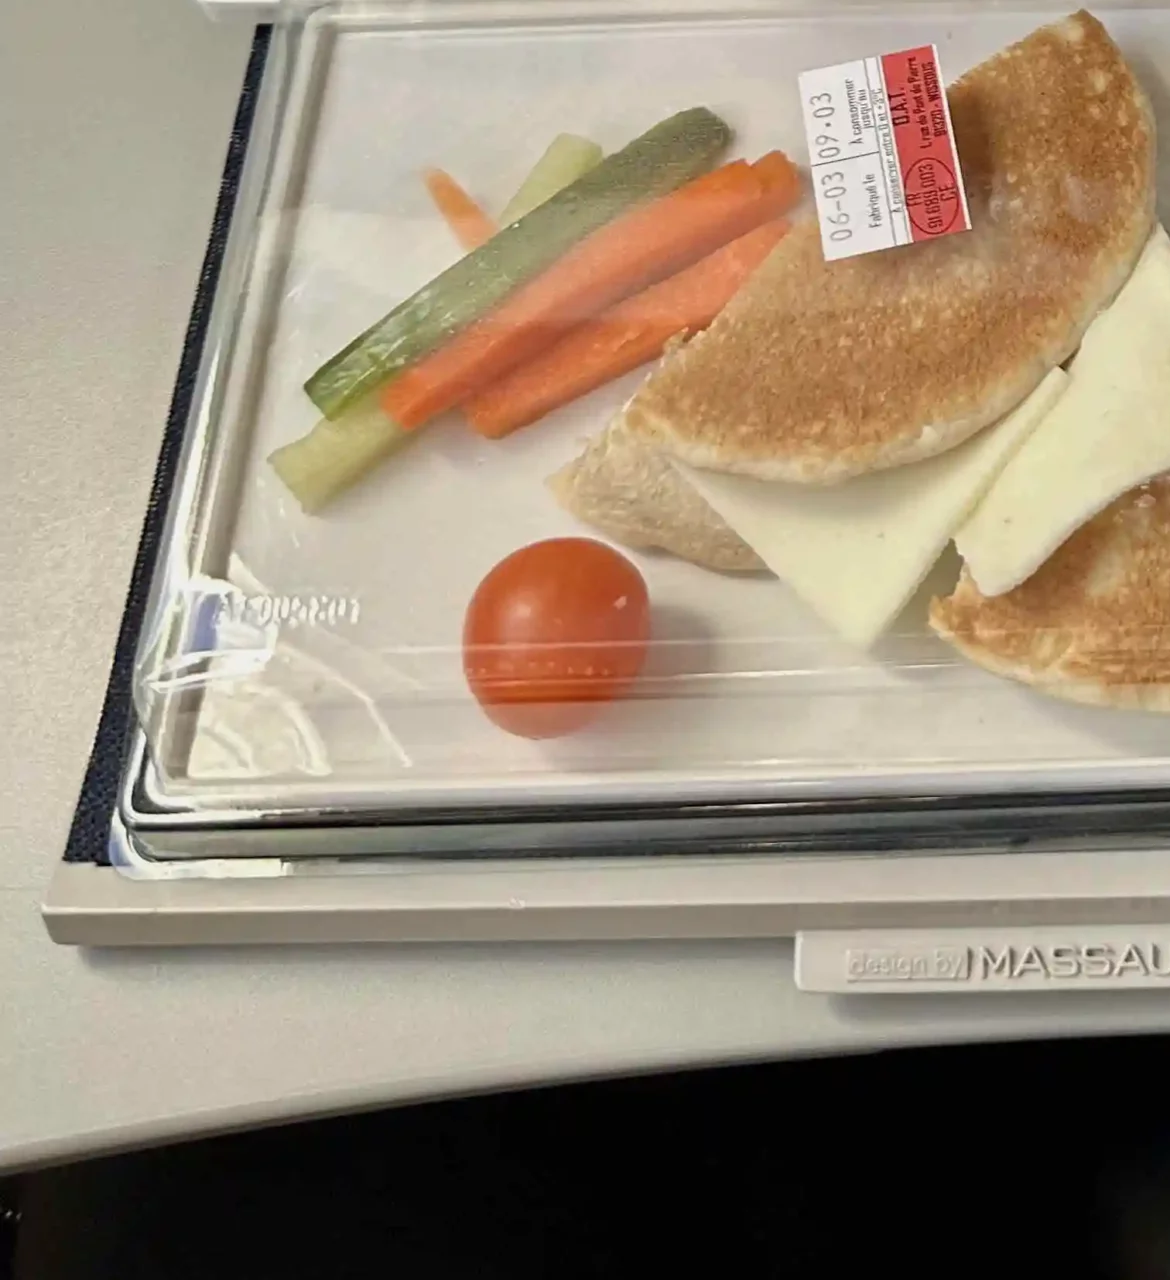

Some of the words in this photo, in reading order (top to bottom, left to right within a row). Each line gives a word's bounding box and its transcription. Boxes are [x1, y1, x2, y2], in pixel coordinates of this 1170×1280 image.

[820, 171, 853, 243] 06-03
[906, 192, 925, 207] FR
[850, 951, 929, 981] design
[935, 947, 966, 979] by
